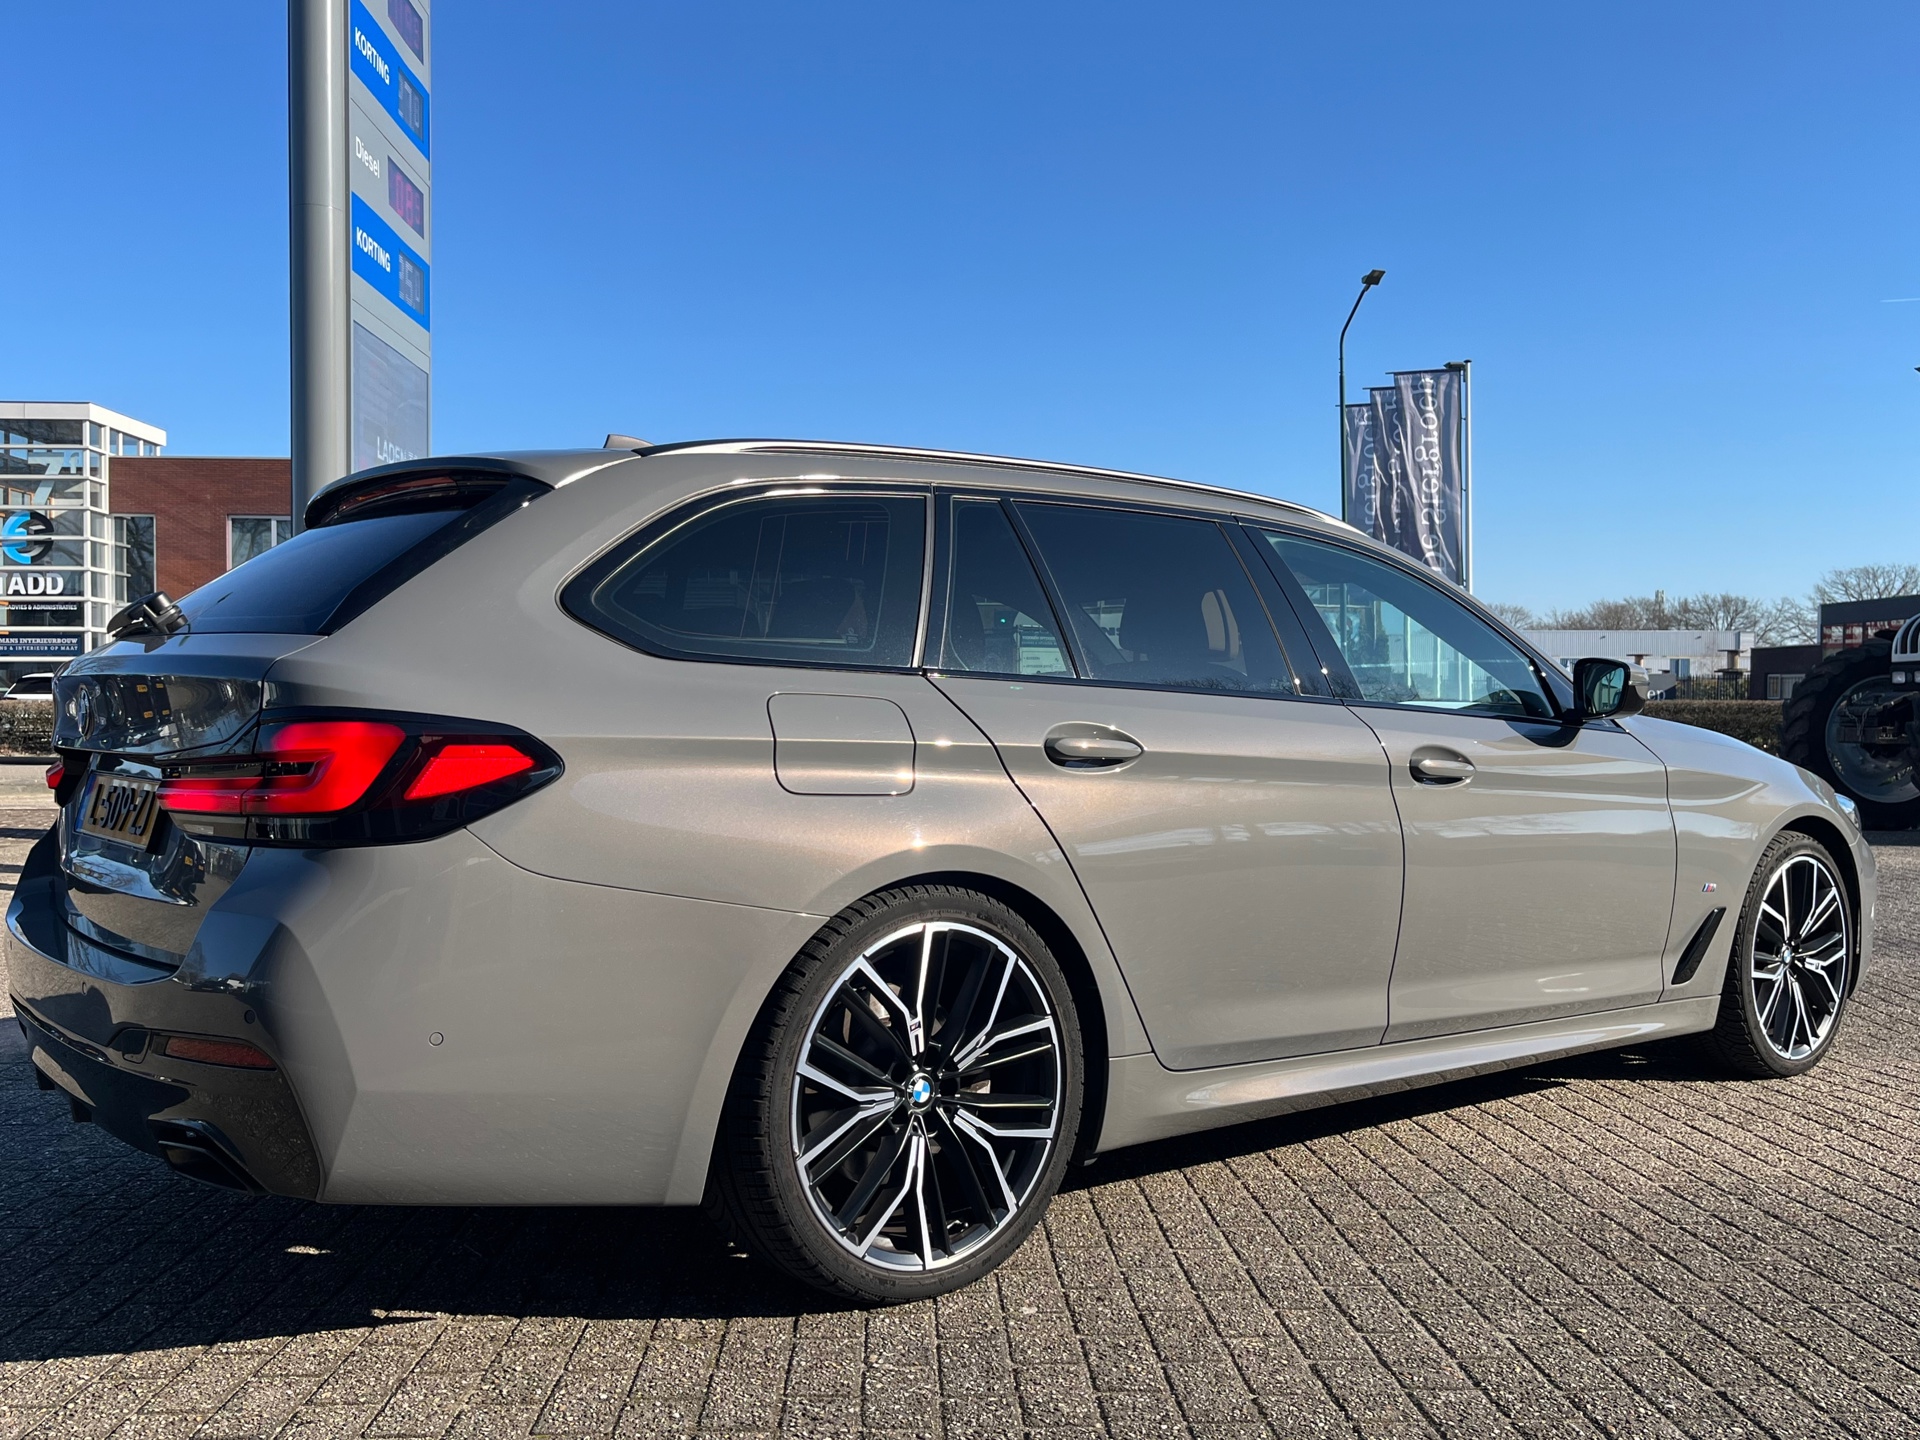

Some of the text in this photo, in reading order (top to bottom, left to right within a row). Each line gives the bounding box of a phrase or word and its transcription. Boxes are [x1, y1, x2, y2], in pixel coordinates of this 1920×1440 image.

[355, 27, 390, 85] KORTING
[355, 136, 380, 178] Diesel
[356, 227, 391, 273] KORTING
